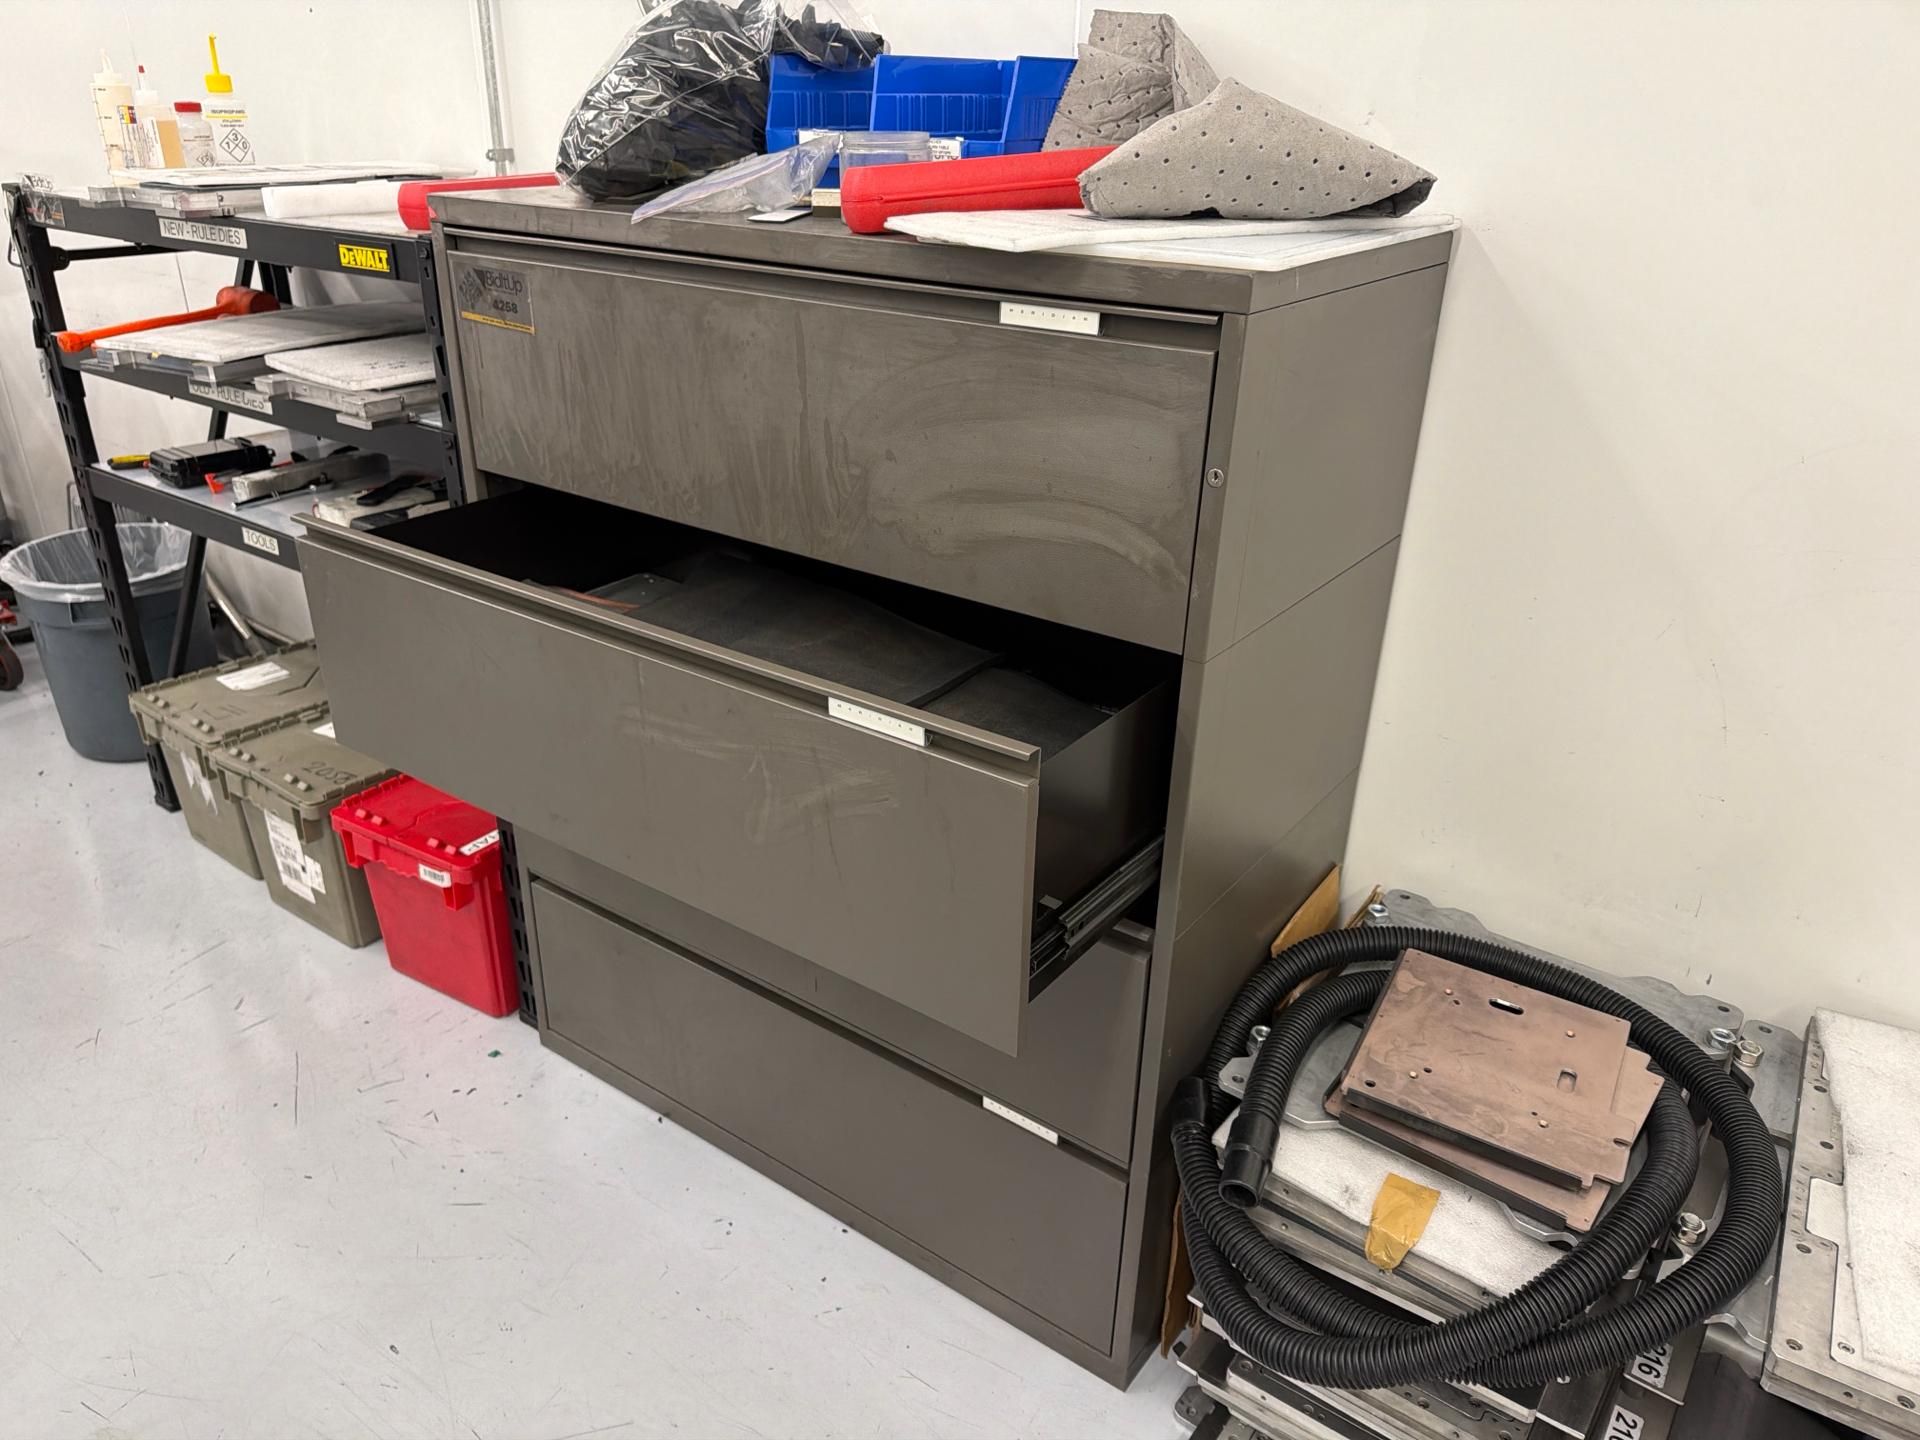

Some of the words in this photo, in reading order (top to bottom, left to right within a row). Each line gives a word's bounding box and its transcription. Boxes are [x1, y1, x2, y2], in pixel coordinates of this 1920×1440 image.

[162, 221, 184, 237] NEW
[191, 224, 217, 242] RULE
[217, 228, 241, 245] DIES
[492, 299, 519, 314] 4258
[217, 386, 241, 404] RULE
[245, 530, 276, 551] TOOLS
[1608, 1411, 1638, 1440] 21
